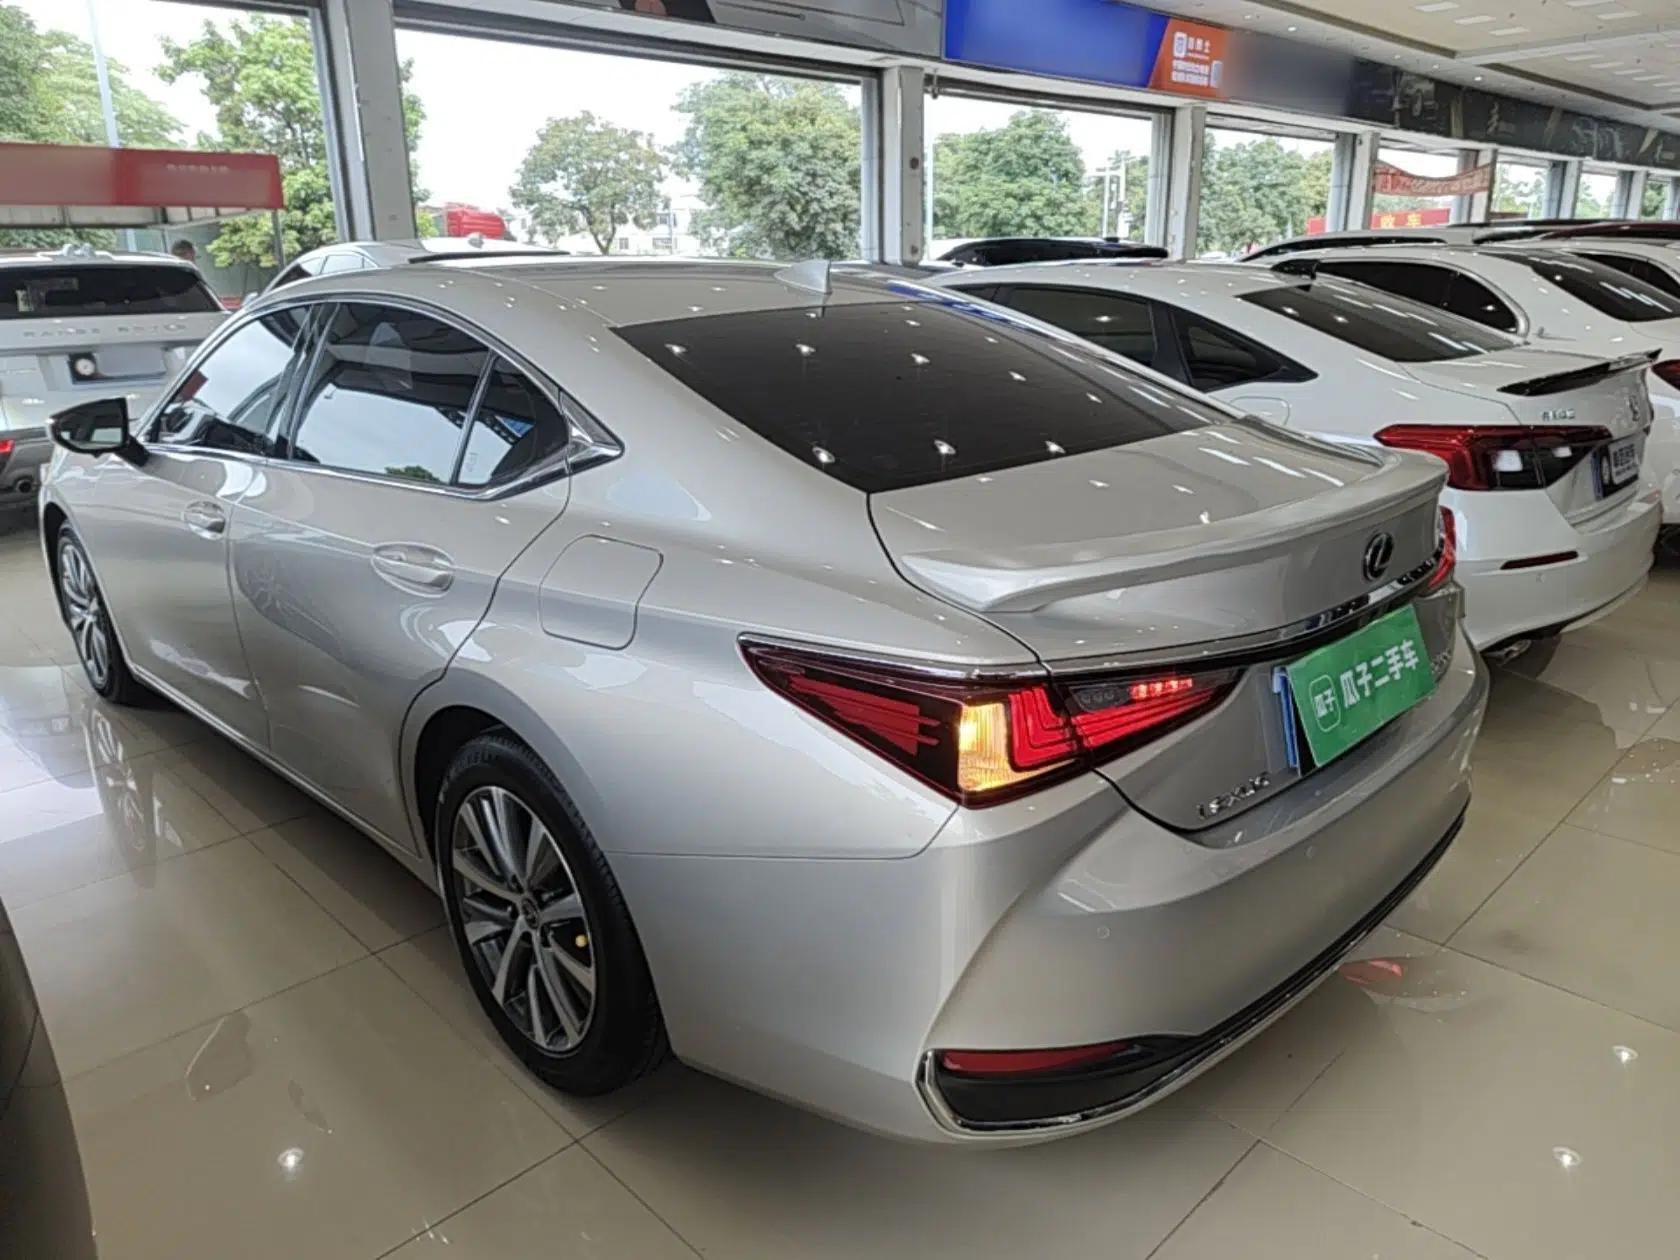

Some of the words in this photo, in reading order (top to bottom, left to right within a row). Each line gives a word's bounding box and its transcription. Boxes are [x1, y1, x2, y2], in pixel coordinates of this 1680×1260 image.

[1340, 638, 1420, 708] 瓜子二手车
[1195, 772, 1270, 820] LEXUS
